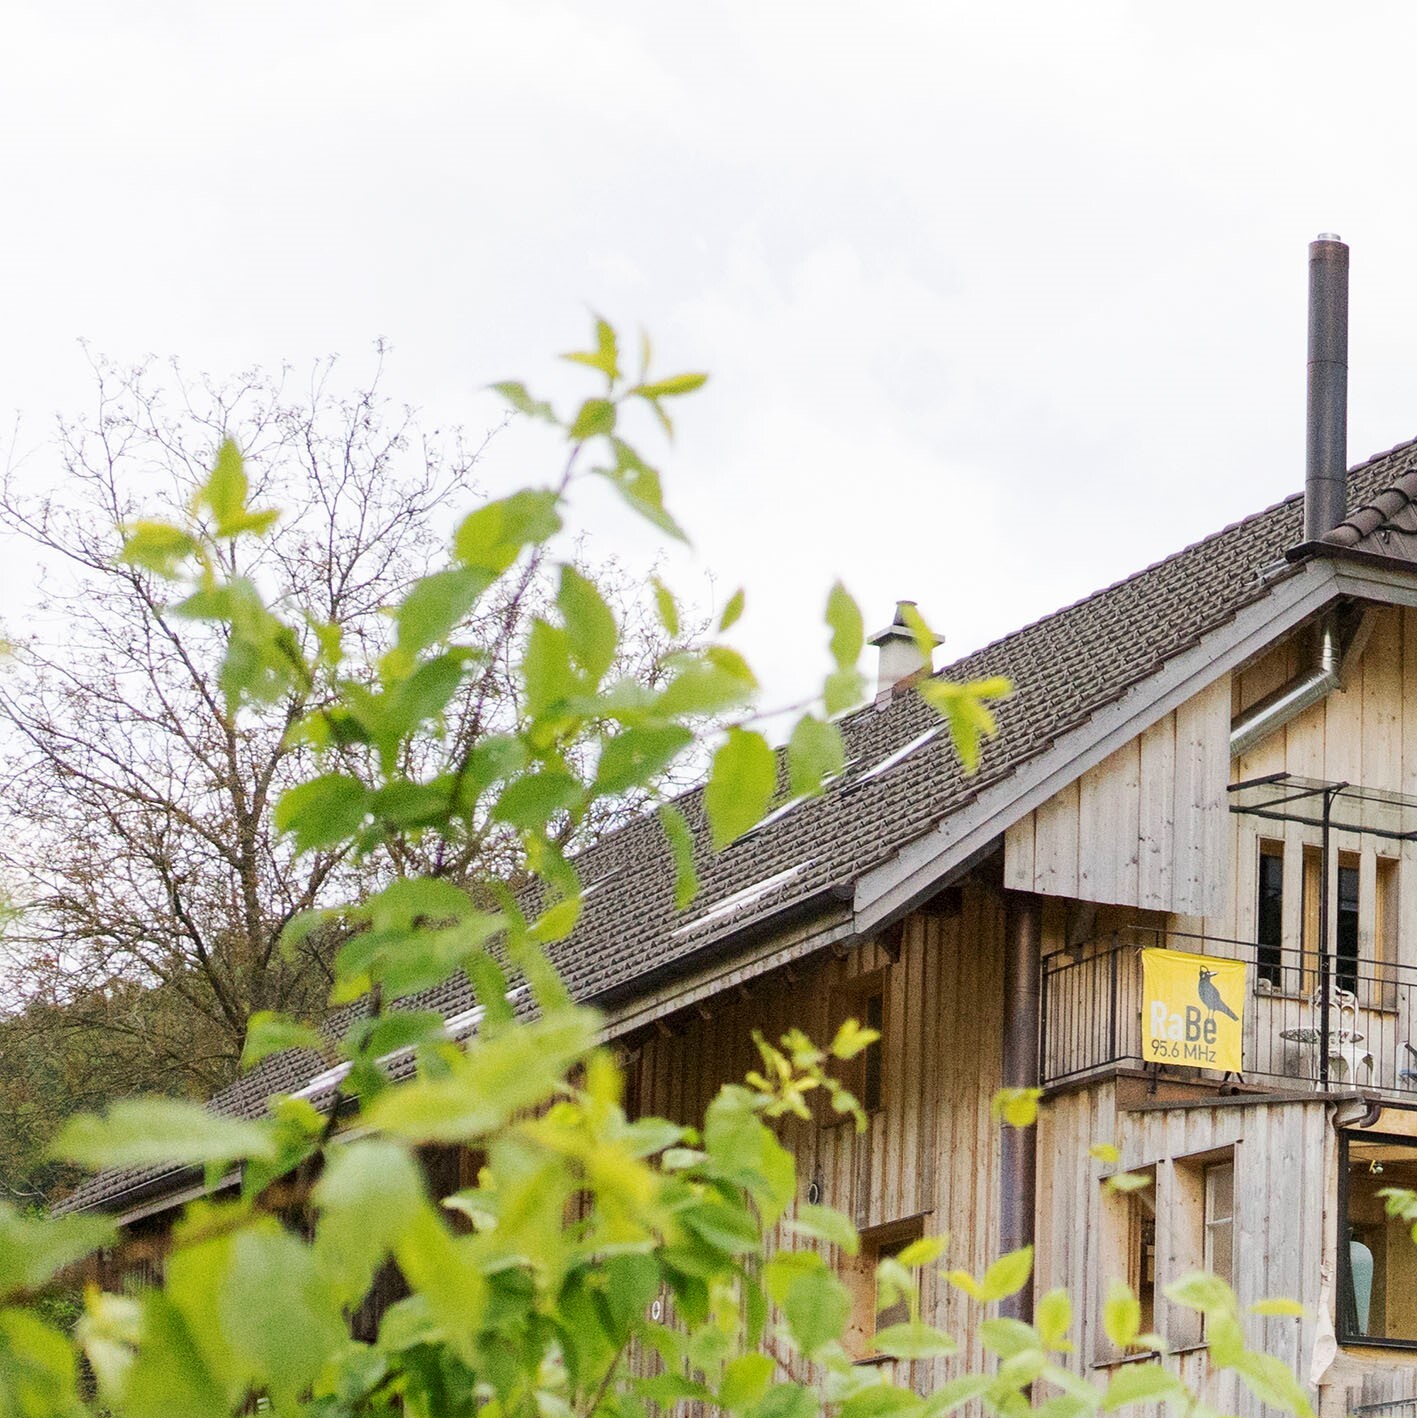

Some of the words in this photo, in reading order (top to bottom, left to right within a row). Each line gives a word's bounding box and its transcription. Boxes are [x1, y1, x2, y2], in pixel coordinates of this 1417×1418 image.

[1150, 1000, 1217, 1045] RaBe
[1151, 1039, 1180, 1058] 95.6
[1184, 1043, 1217, 1063] MHz
